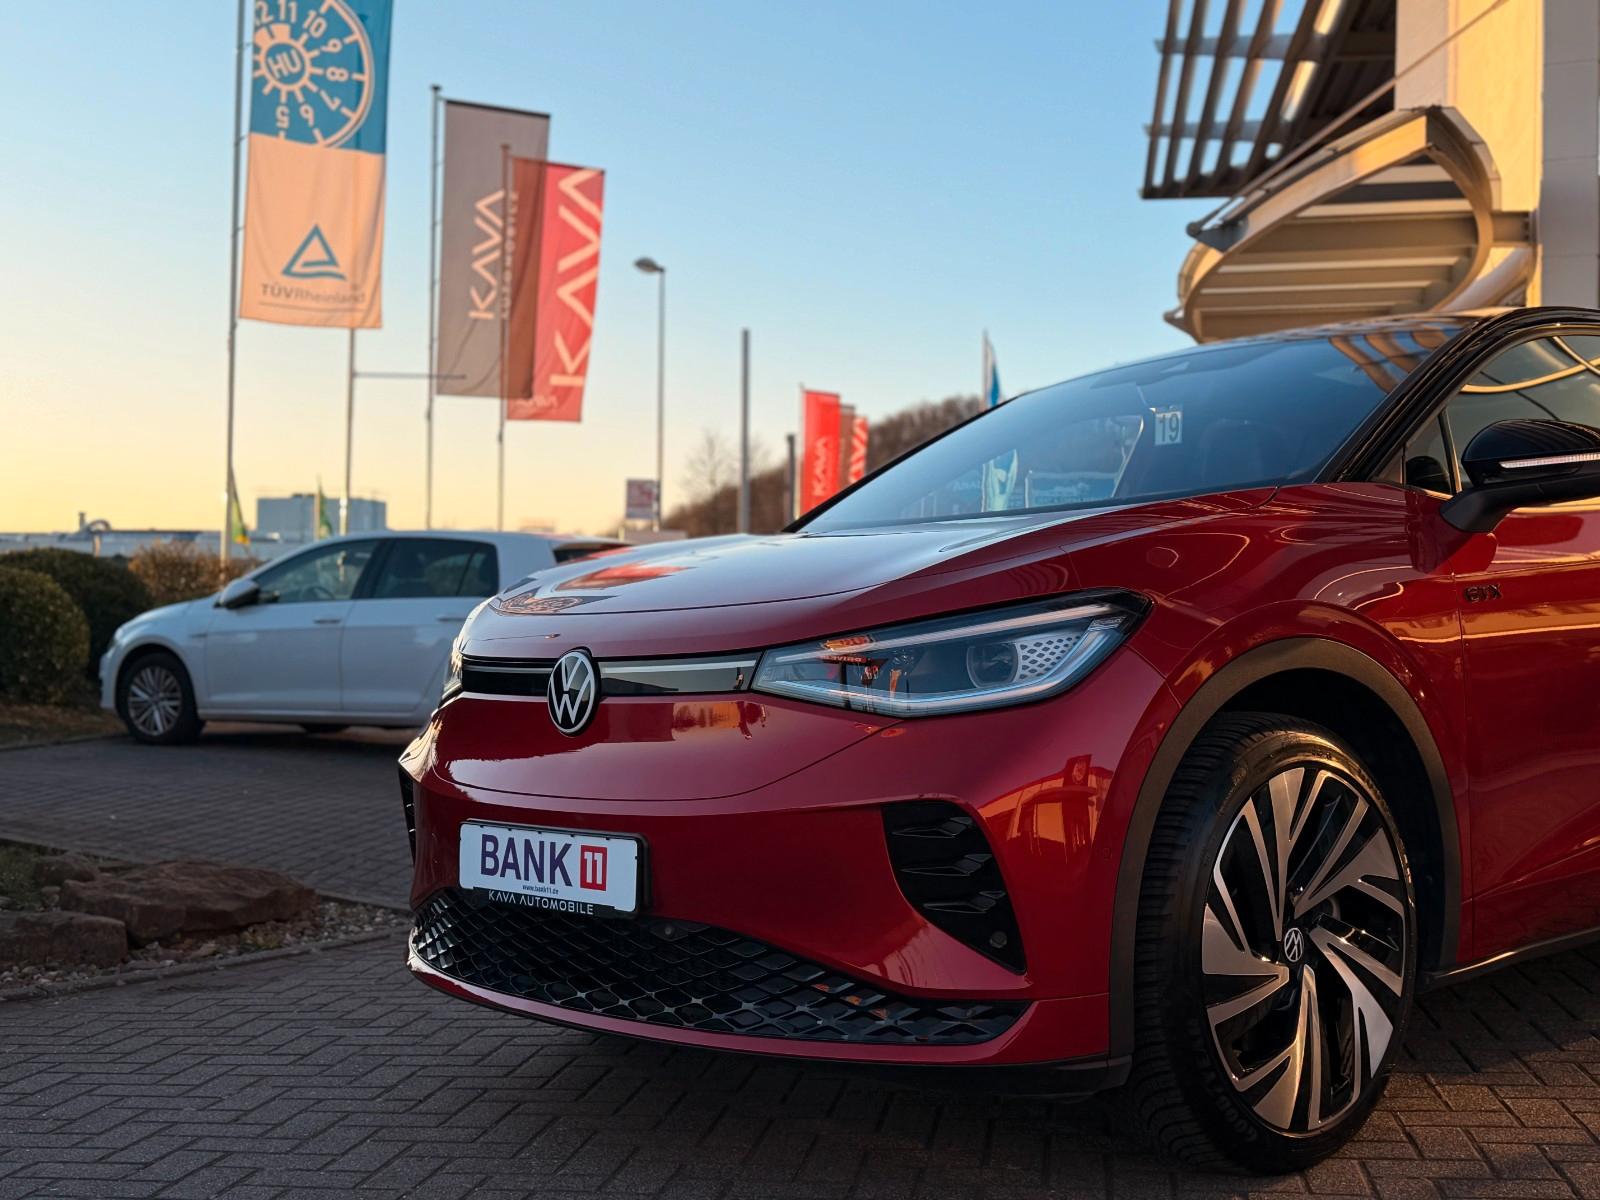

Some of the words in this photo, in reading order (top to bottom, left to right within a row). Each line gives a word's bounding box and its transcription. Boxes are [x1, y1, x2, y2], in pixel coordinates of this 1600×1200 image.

[302, 10, 327, 38] 10
[267, 49, 302, 79] HU
[325, 66, 349, 82] 8
[320, 90, 341, 111] 7
[276, 105, 289, 128] 5
[469, 189, 505, 320] KAVA
[549, 168, 603, 387] KAVA
[1158, 412, 1180, 443] 19
[480, 833, 573, 887] BANK
[583, 850, 604, 887] 11
[488, 889, 516, 905] KAVA
[519, 894, 594, 916] AUTOMOBILE
[522, 884, 559, 895] www.bank11.de
